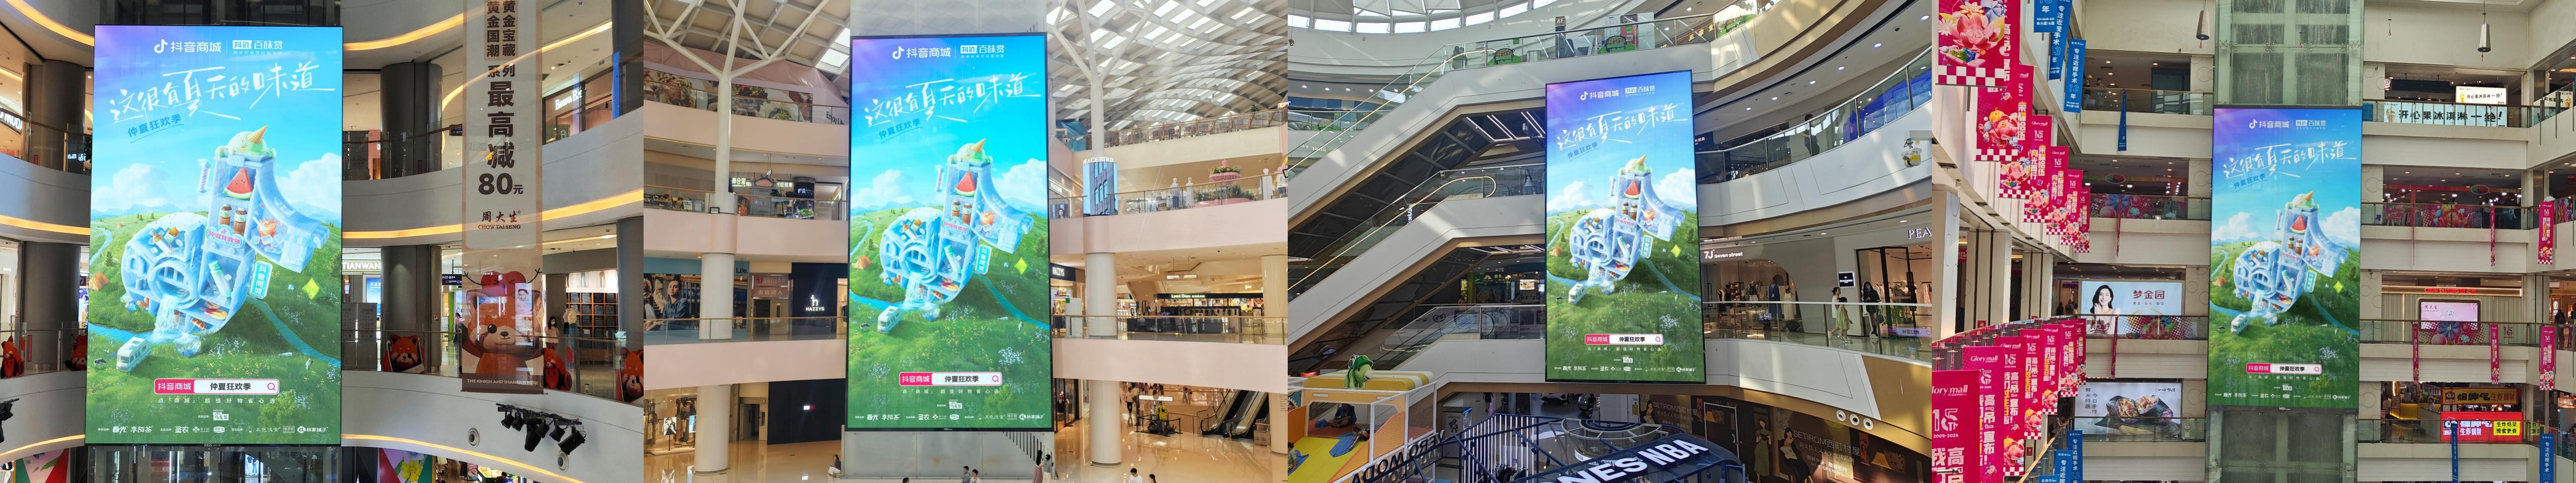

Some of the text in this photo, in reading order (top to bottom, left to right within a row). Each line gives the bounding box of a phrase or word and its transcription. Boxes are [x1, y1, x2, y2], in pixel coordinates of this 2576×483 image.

[487, 1, 499, 57] 黄金国潮
[502, 0, 515, 56] 黄金宝藏
[171, 41, 221, 53] 抖音商城
[254, 40, 283, 49] 百味赏
[979, 44, 1005, 53] 百味赏
[907, 47, 951, 58] 抖音商城
[488, 64, 515, 77] 系列
[2071, 48, 2080, 83] 专注近视手术
[110, 61, 336, 124] 这很有夏天的味道
[864, 72, 1042, 127] 这很有夏天的味道
[1589, 89, 1619, 100] 抖音商城
[555, 95, 573, 111] BANANA
[128, 114, 182, 138] 仲夏狂欢季
[487, 81, 514, 169] 最高减
[879, 118, 921, 139] 仲夏狂欢季
[1557, 103, 1688, 150] 这很有夏天的味道
[2259, 121, 2289, 129] 抖音商城
[1567, 142, 1598, 159] 仲夏狂欢季
[1083, 157, 1113, 165] PEACEBIRD
[2030, 150, 2038, 180] 向光而行
[2224, 140, 2357, 179] 这很有夏天的味道
[478, 172, 523, 195] 80元
[2234, 173, 2266, 188] 仲夏狂欢季
[482, 210, 517, 223] 周大生
[1908, 227, 1932, 240] PEA
[1052, 266, 1064, 276] HAZZYS
[254, 265, 267, 295] 抖音商城
[2133, 290, 2165, 300] 梦金园
[210, 382, 251, 391] 仲夏狂欢季
[1932, 384, 1968, 396] lory mall
[2491, 393, 2515, 401] 生炸鸡架
[2460, 428, 2481, 436] 生炸鸡架
[1637, 439, 1709, 466] NBA
